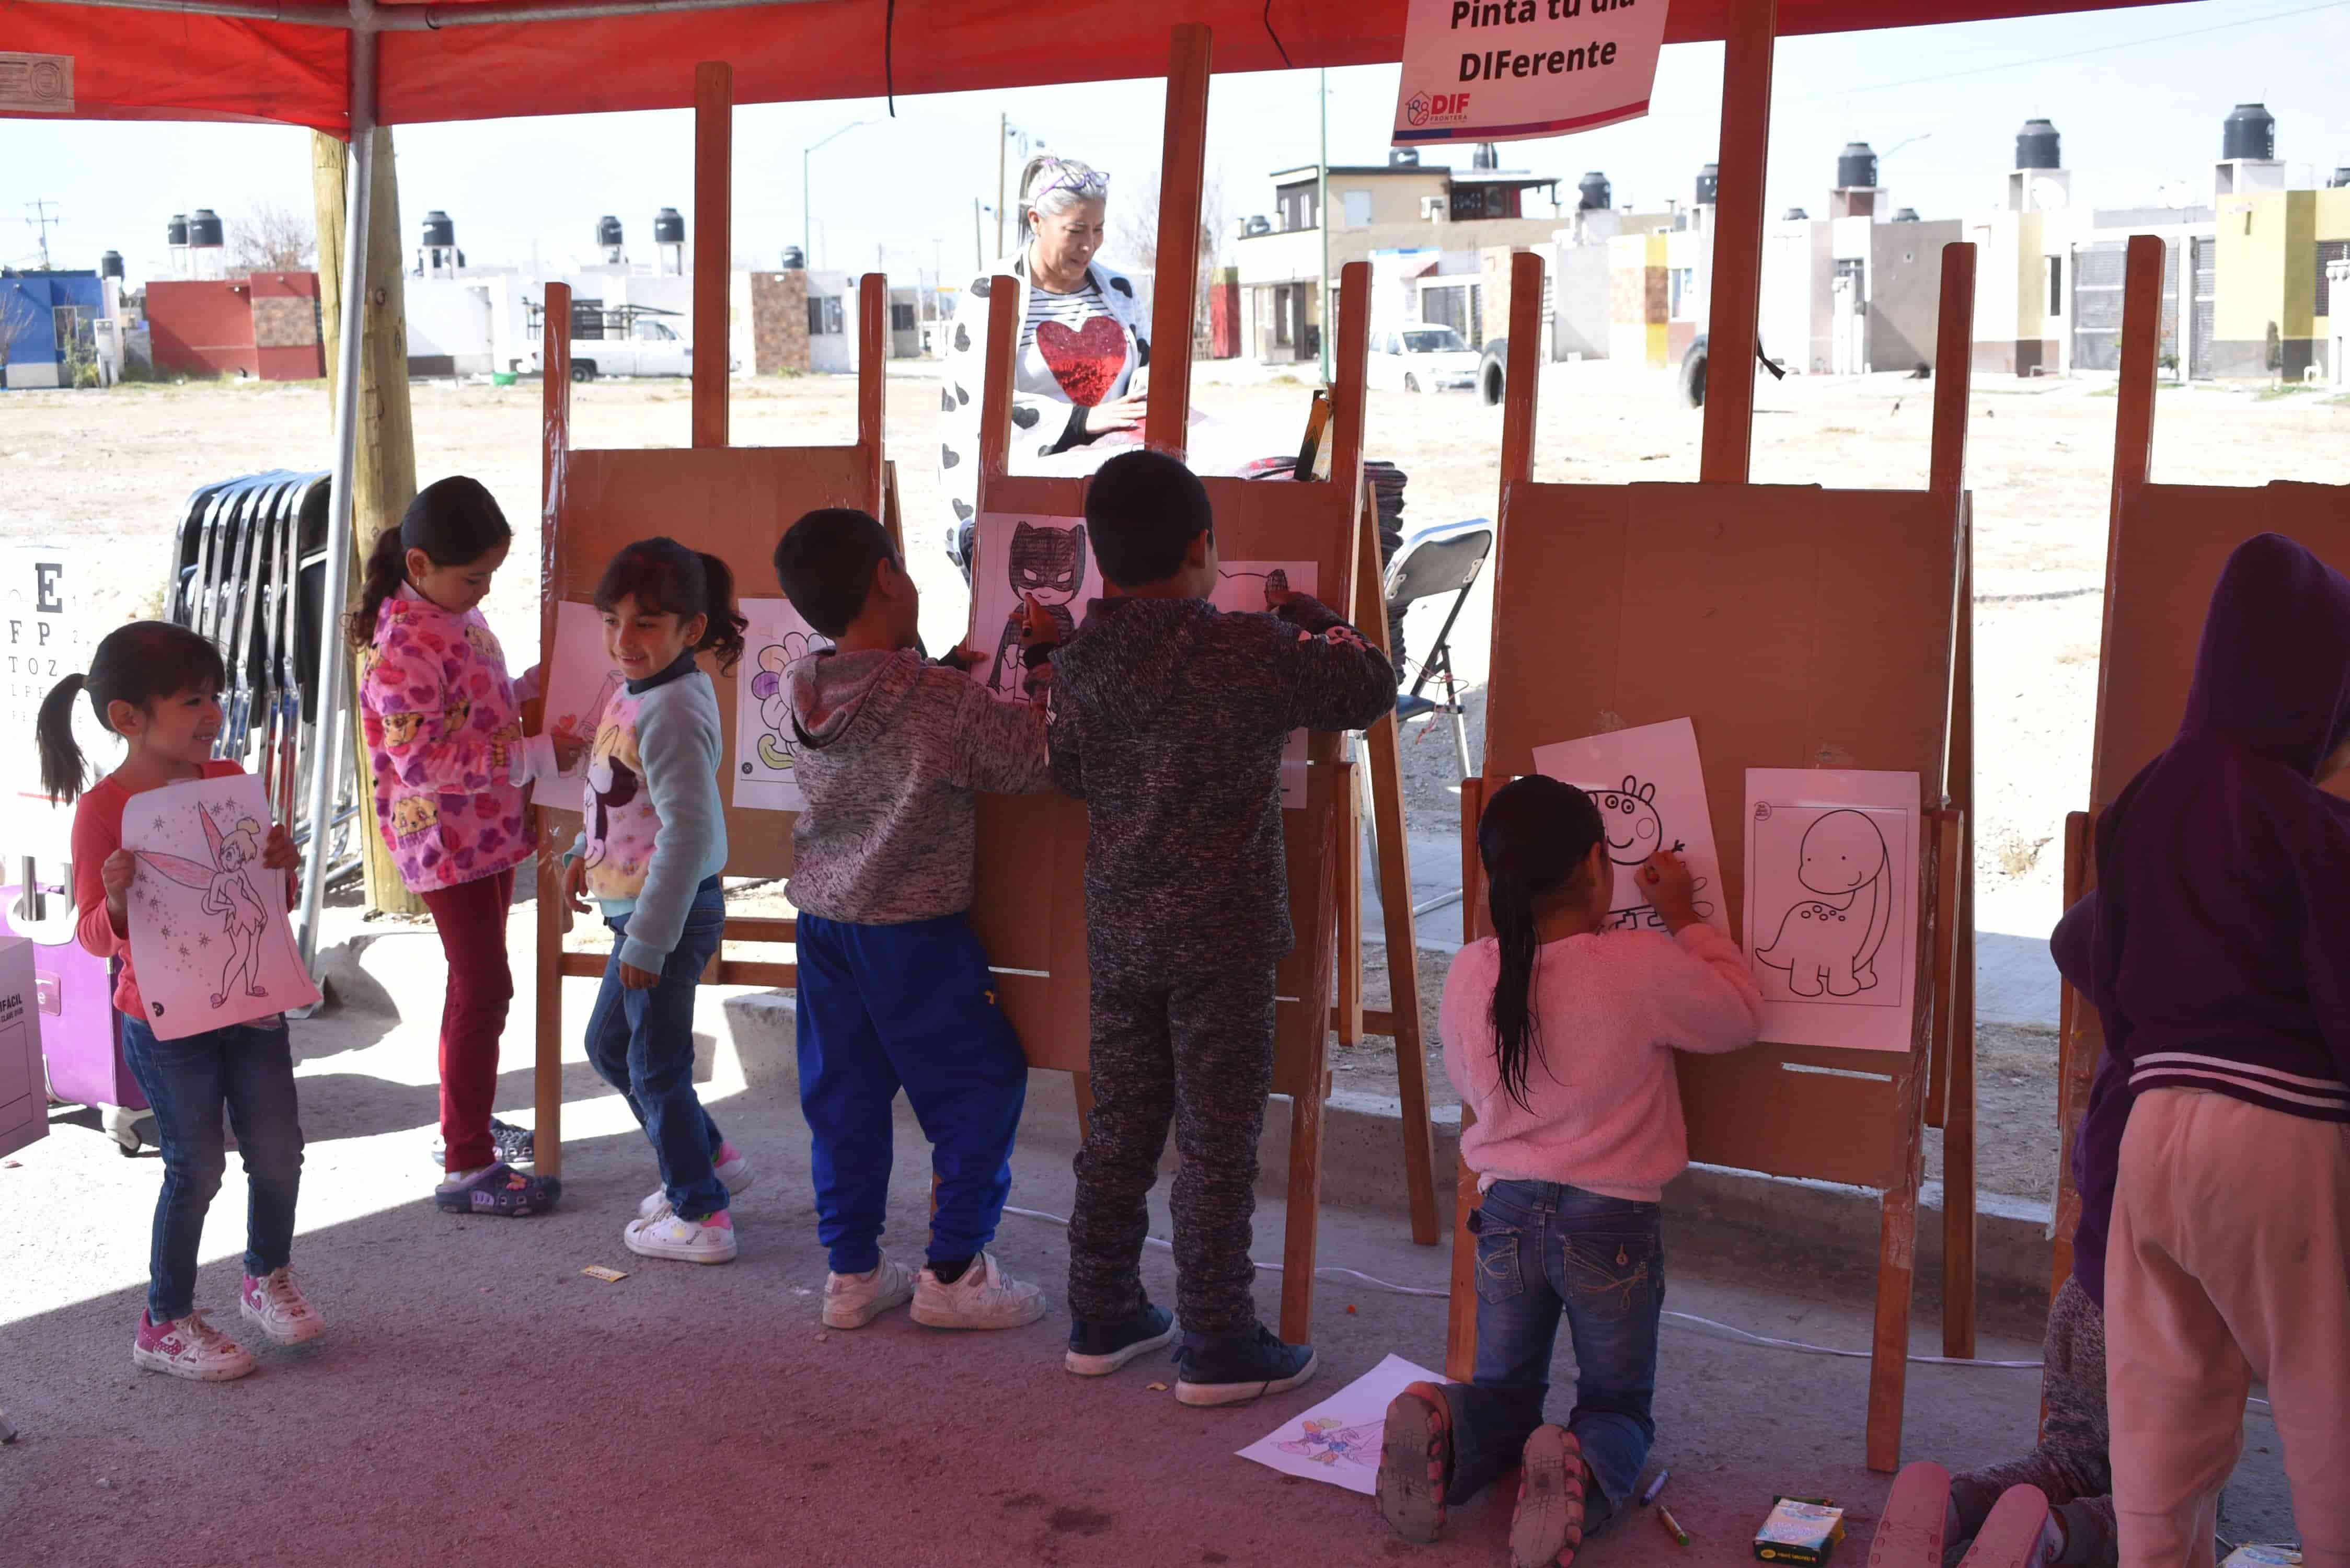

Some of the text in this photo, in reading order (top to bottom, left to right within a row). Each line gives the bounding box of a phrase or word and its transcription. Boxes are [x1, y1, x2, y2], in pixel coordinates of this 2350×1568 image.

[1451, 0, 1536, 29] Pinta
[1548, 0, 1580, 20] tu
[1459, 40, 1617, 82] DIFerente
[1431, 93, 1470, 114] DIF
[35, 562, 63, 613] E
[9, 620, 22, 643] F
[37, 622, 50, 645] P
